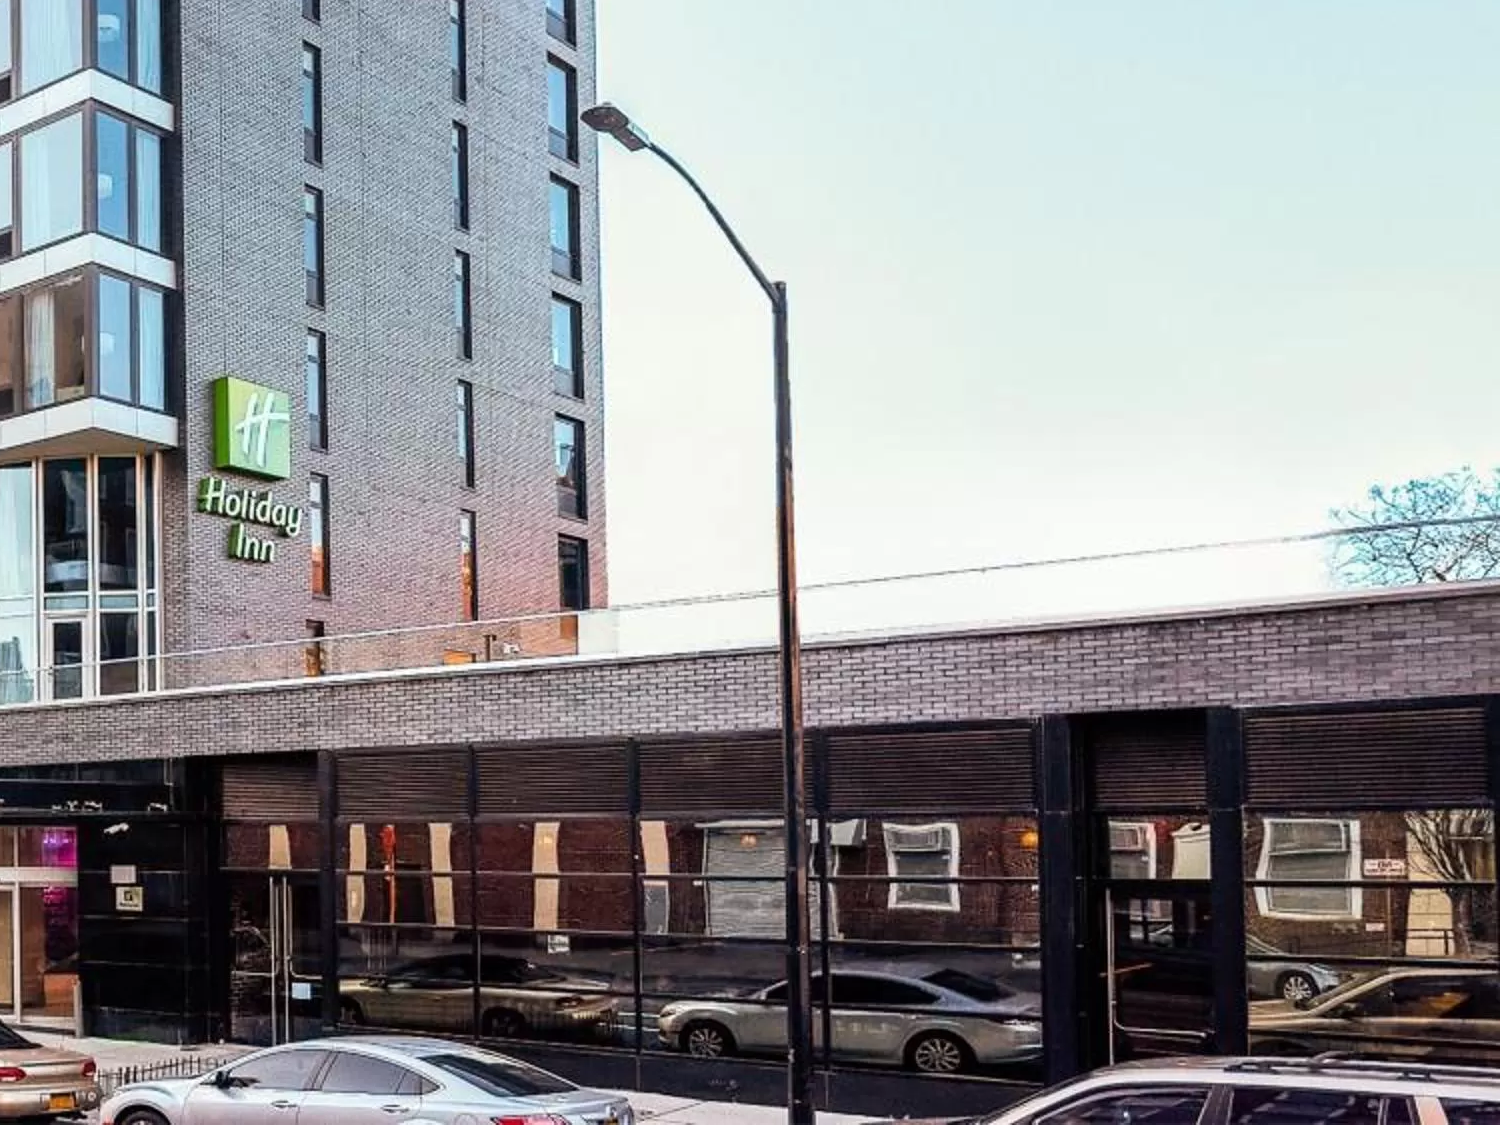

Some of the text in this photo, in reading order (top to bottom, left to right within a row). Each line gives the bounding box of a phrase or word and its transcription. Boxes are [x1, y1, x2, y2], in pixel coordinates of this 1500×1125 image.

[234, 391, 290, 468] H
[199, 477, 303, 537] Holiday
[232, 522, 275, 563] Inn
